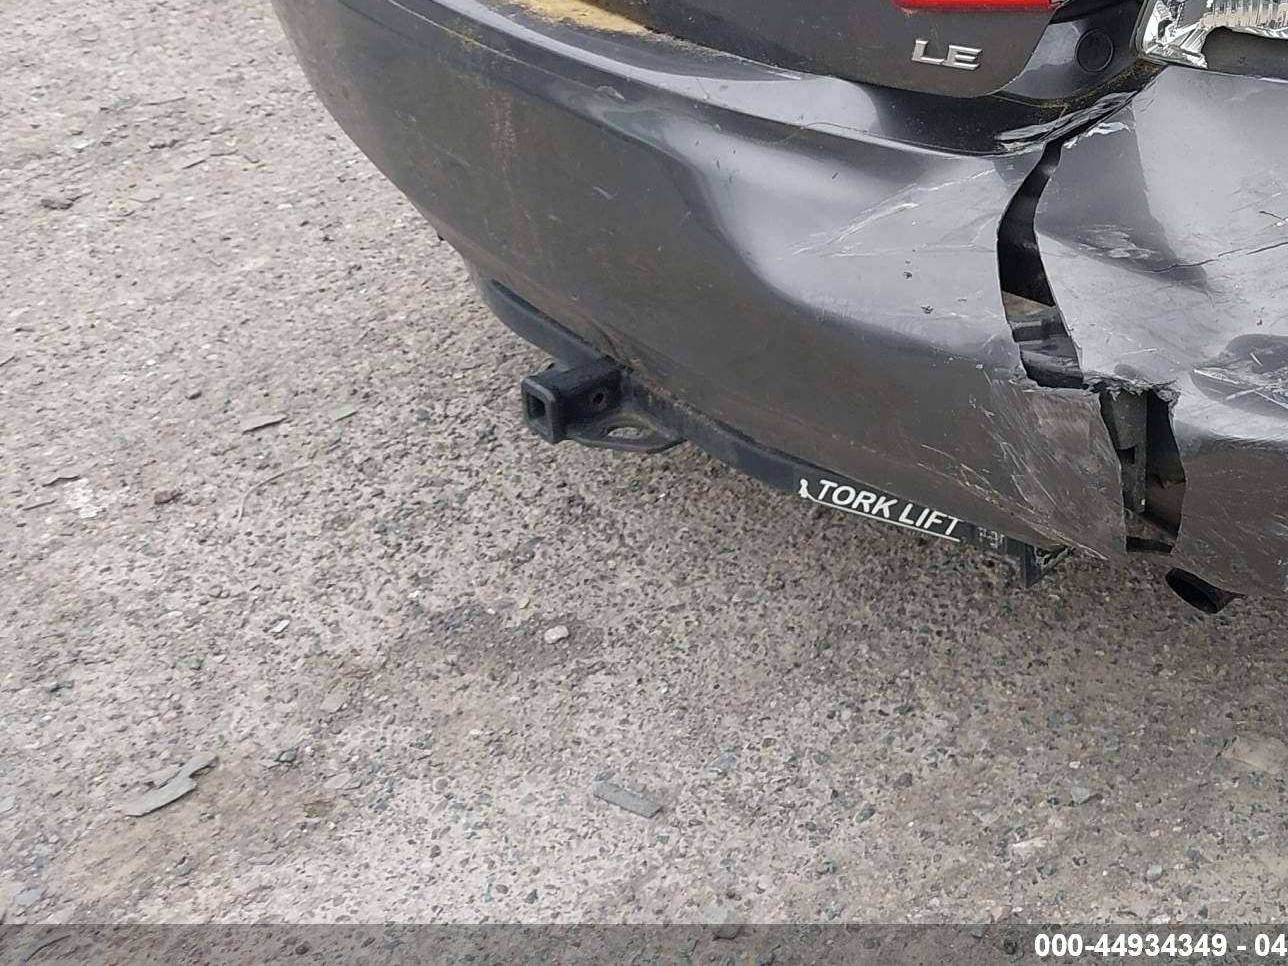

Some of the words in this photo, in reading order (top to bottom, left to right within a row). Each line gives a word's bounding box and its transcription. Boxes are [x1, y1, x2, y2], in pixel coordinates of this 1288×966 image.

[911, 38, 983, 71] LE
[817, 479, 898, 519] TORK
[899, 503, 963, 536] LIFT
